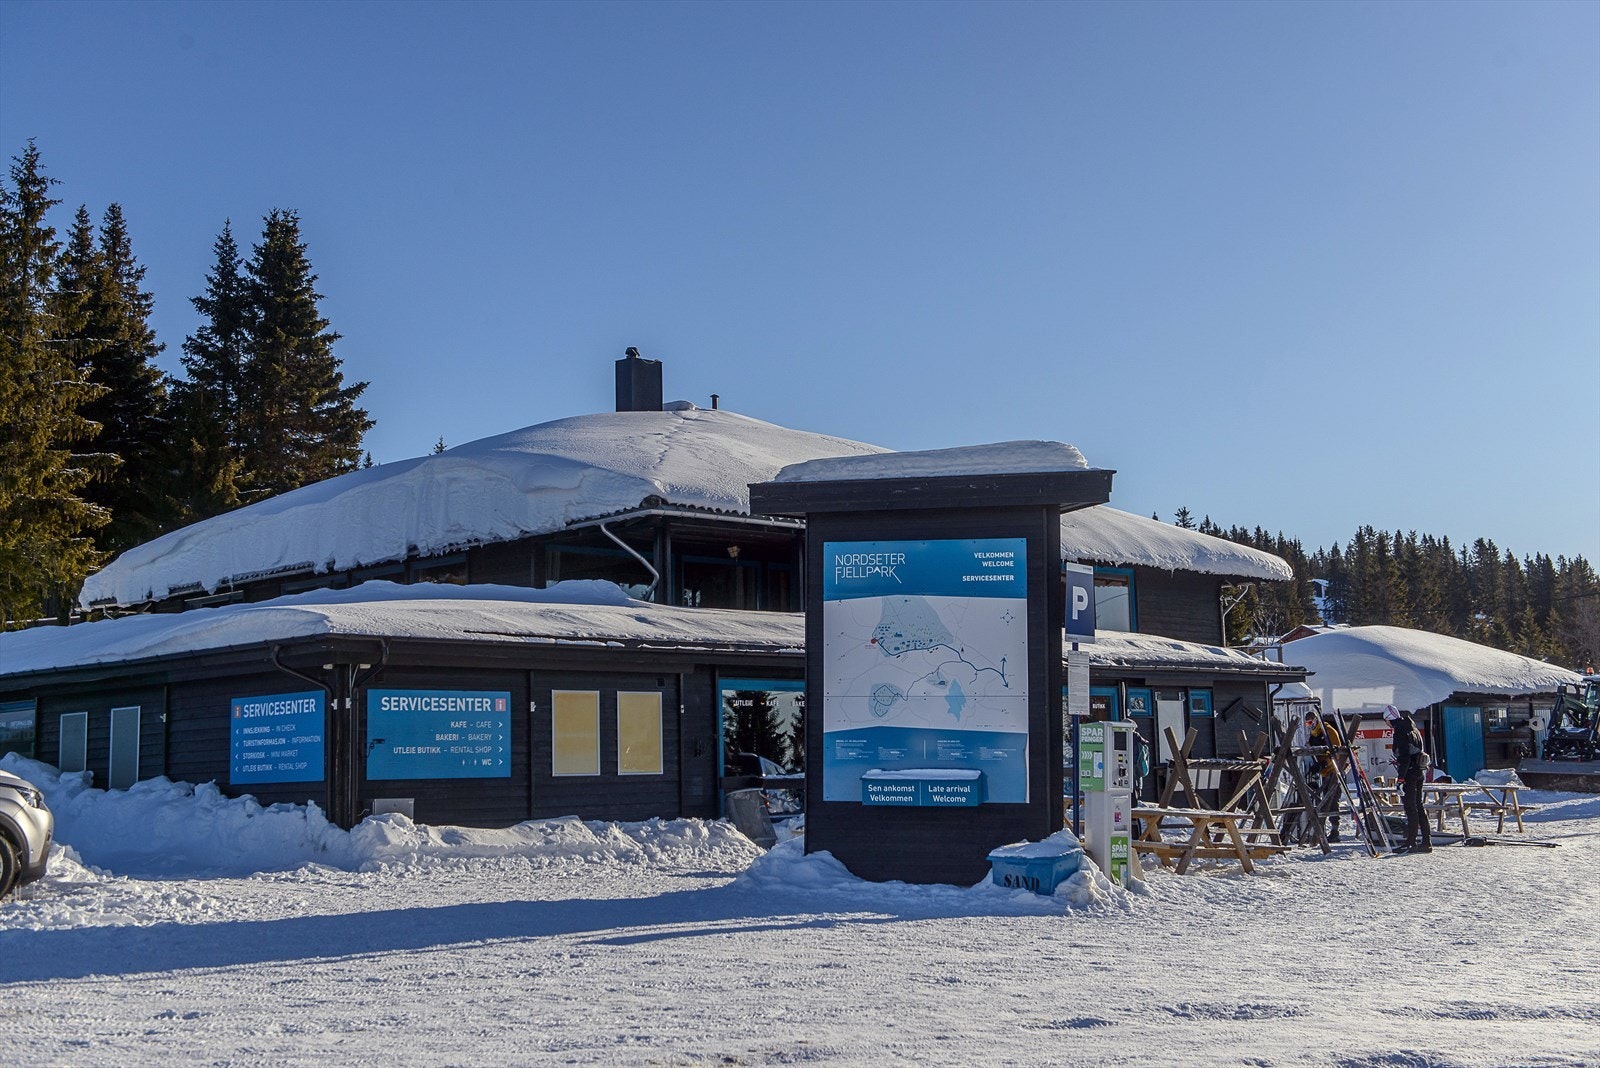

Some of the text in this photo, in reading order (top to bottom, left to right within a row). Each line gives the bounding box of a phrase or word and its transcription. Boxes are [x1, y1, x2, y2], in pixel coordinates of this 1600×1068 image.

[835, 553, 906, 566] NORDSETER
[835, 566, 902, 584] FJELLPARK
[1072, 586, 1088, 620] P
[243, 699, 316, 718] SERVICESENTER
[381, 696, 492, 712] SERVICESENTER
[243, 726, 270, 734] INNSJEKKING
[1081, 727, 1103, 737] SPAR
[243, 738, 286, 747] TURISTINFORMASJON
[291, 736, 321, 744] INFORMATION
[1112, 845, 1127, 853] SPAR
[1004, 874, 1040, 892] SAND
